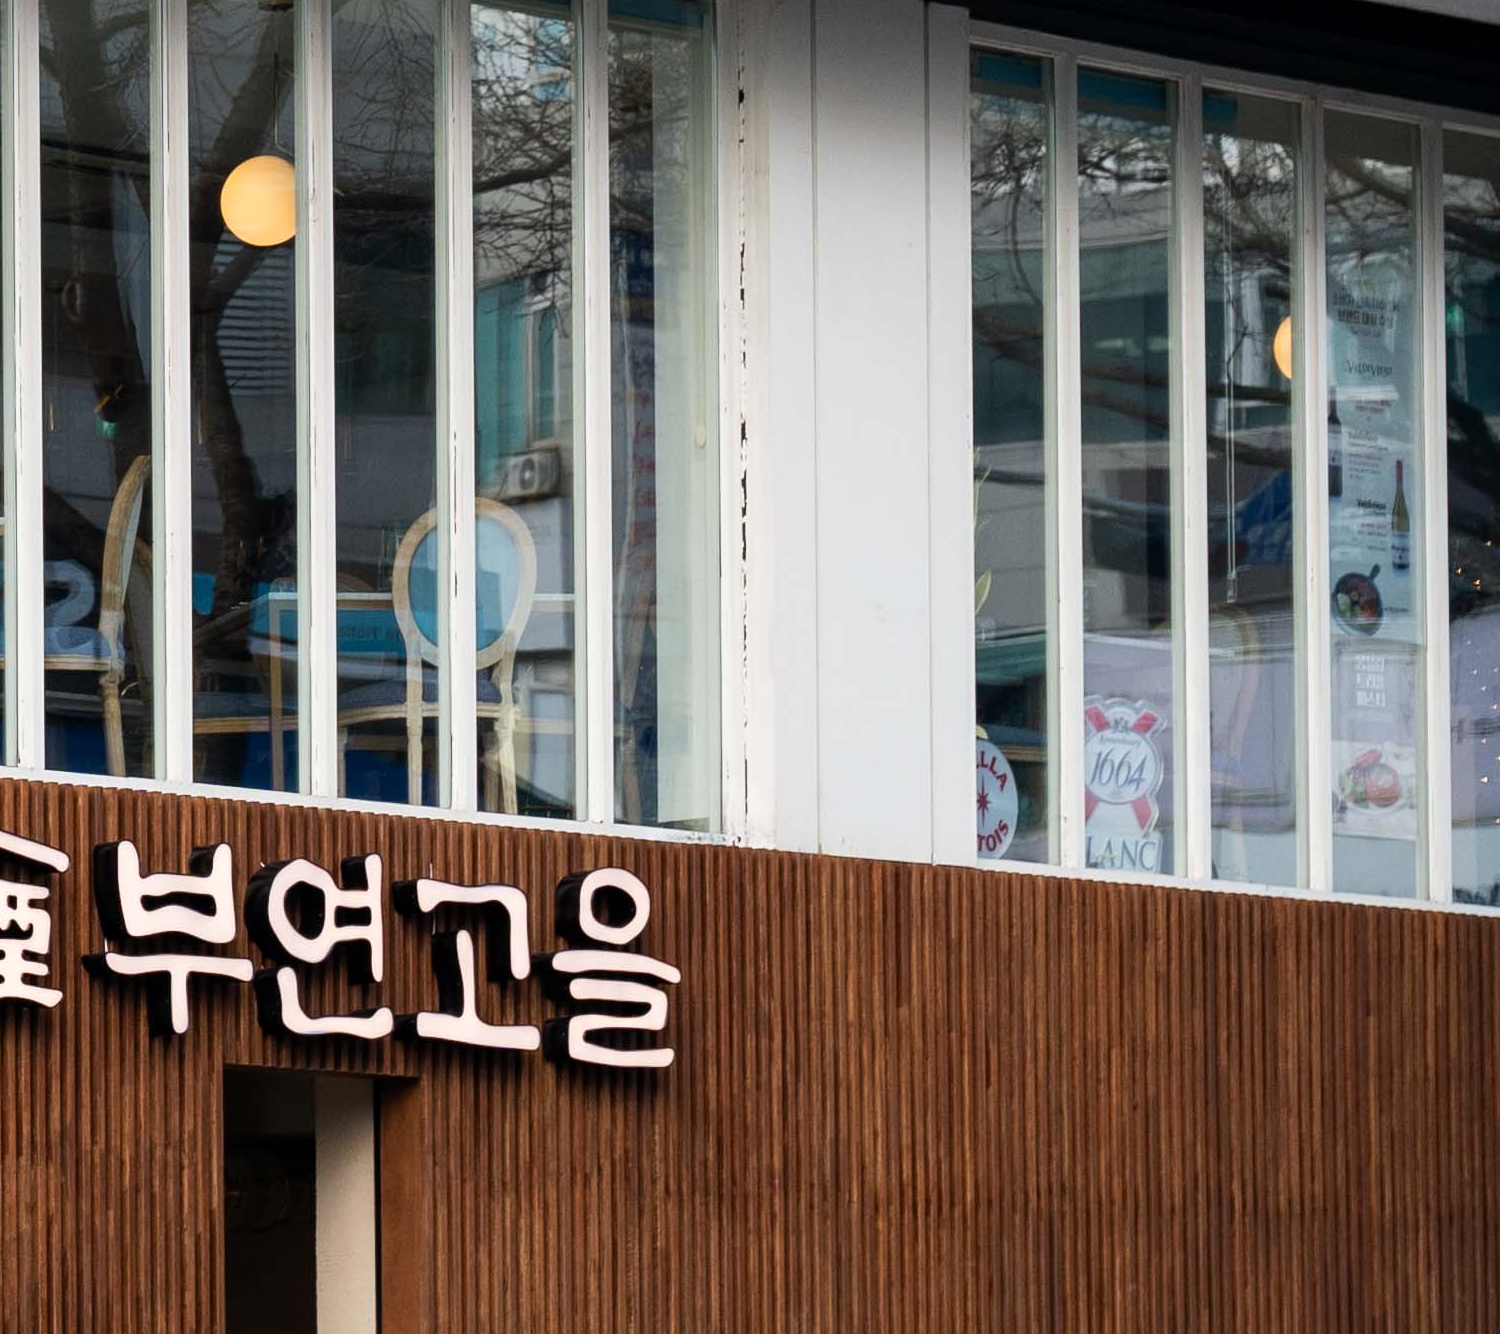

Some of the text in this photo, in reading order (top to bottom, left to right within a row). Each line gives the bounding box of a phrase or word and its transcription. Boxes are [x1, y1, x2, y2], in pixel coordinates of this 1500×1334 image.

[1090, 747, 1147, 791] 1664
[1085, 835, 1157, 872] LANC
[104, 840, 682, 1068] 부연고을
